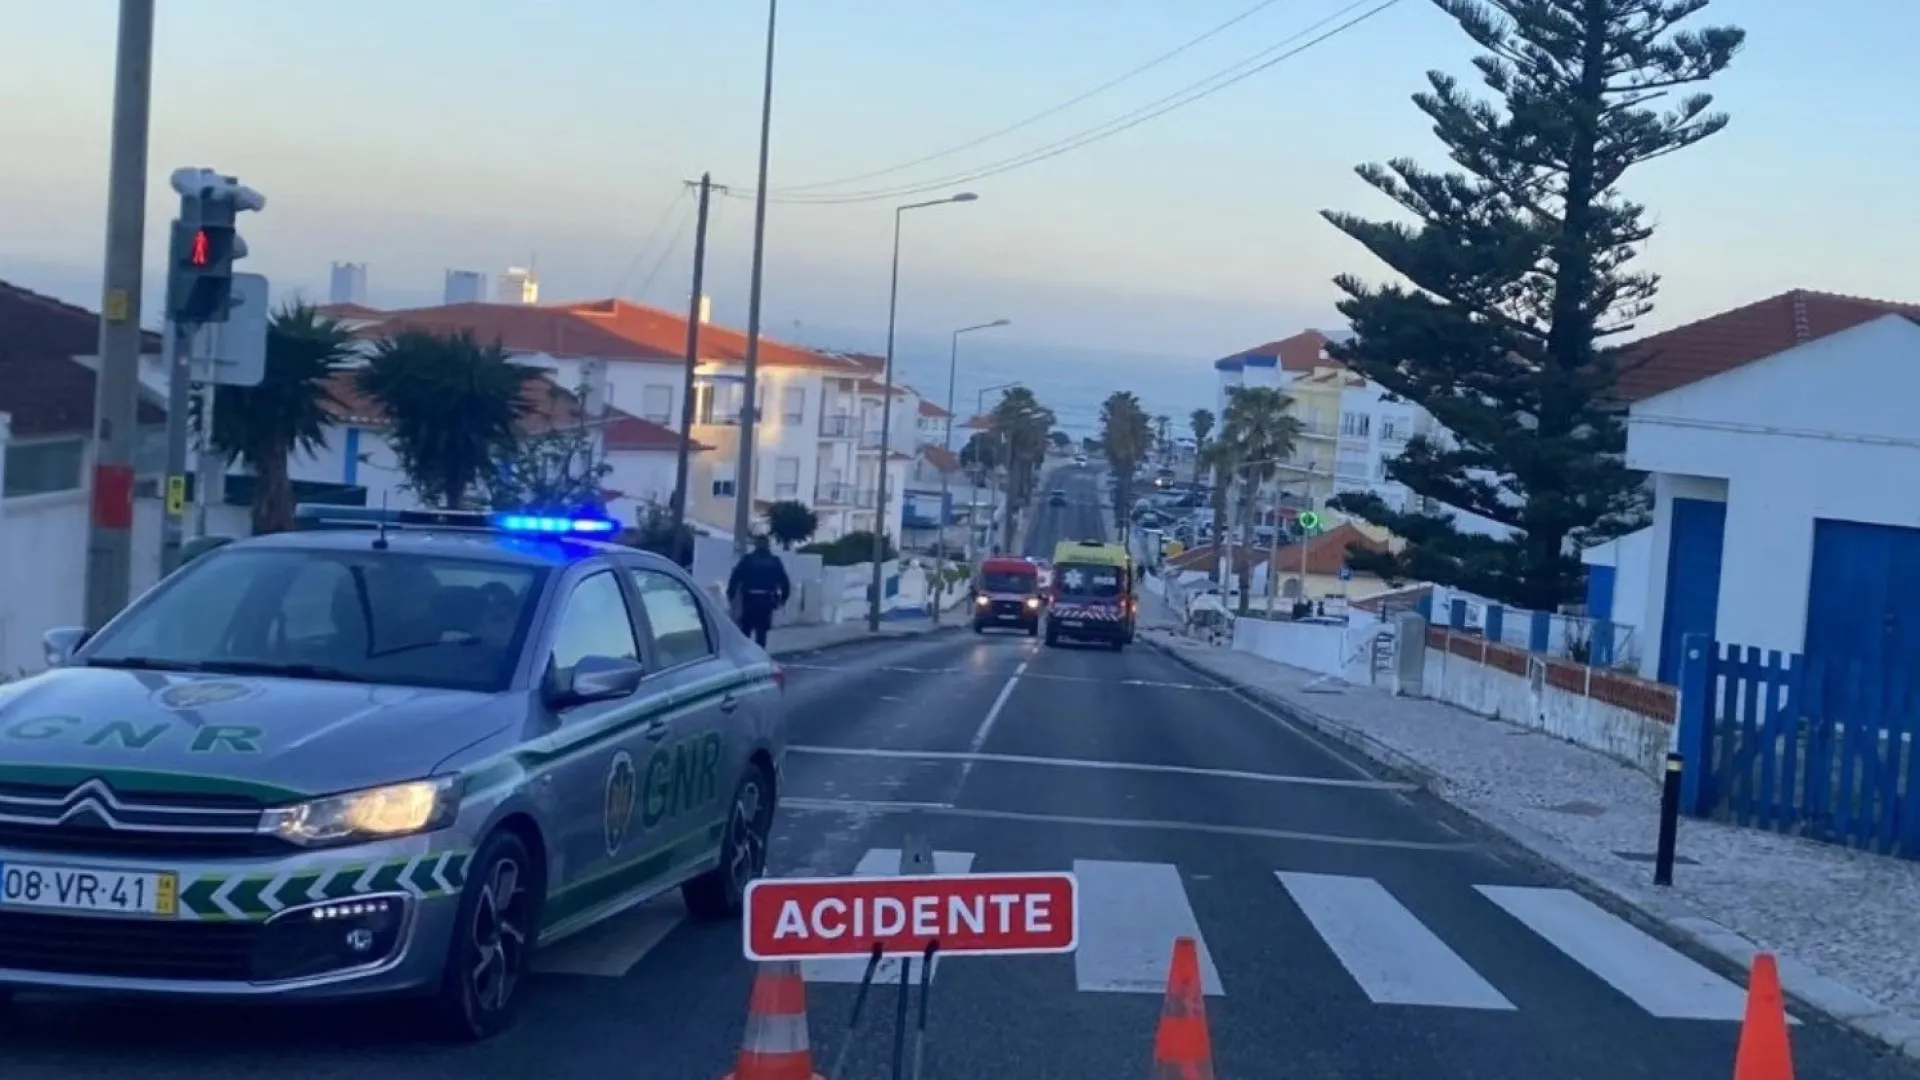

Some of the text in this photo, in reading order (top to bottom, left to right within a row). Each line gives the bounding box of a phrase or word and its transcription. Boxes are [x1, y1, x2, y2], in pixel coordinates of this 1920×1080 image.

[5, 715, 264, 753] GNR
[643, 732, 720, 829] GNR
[773, 893, 1052, 939] ACIDENTE
